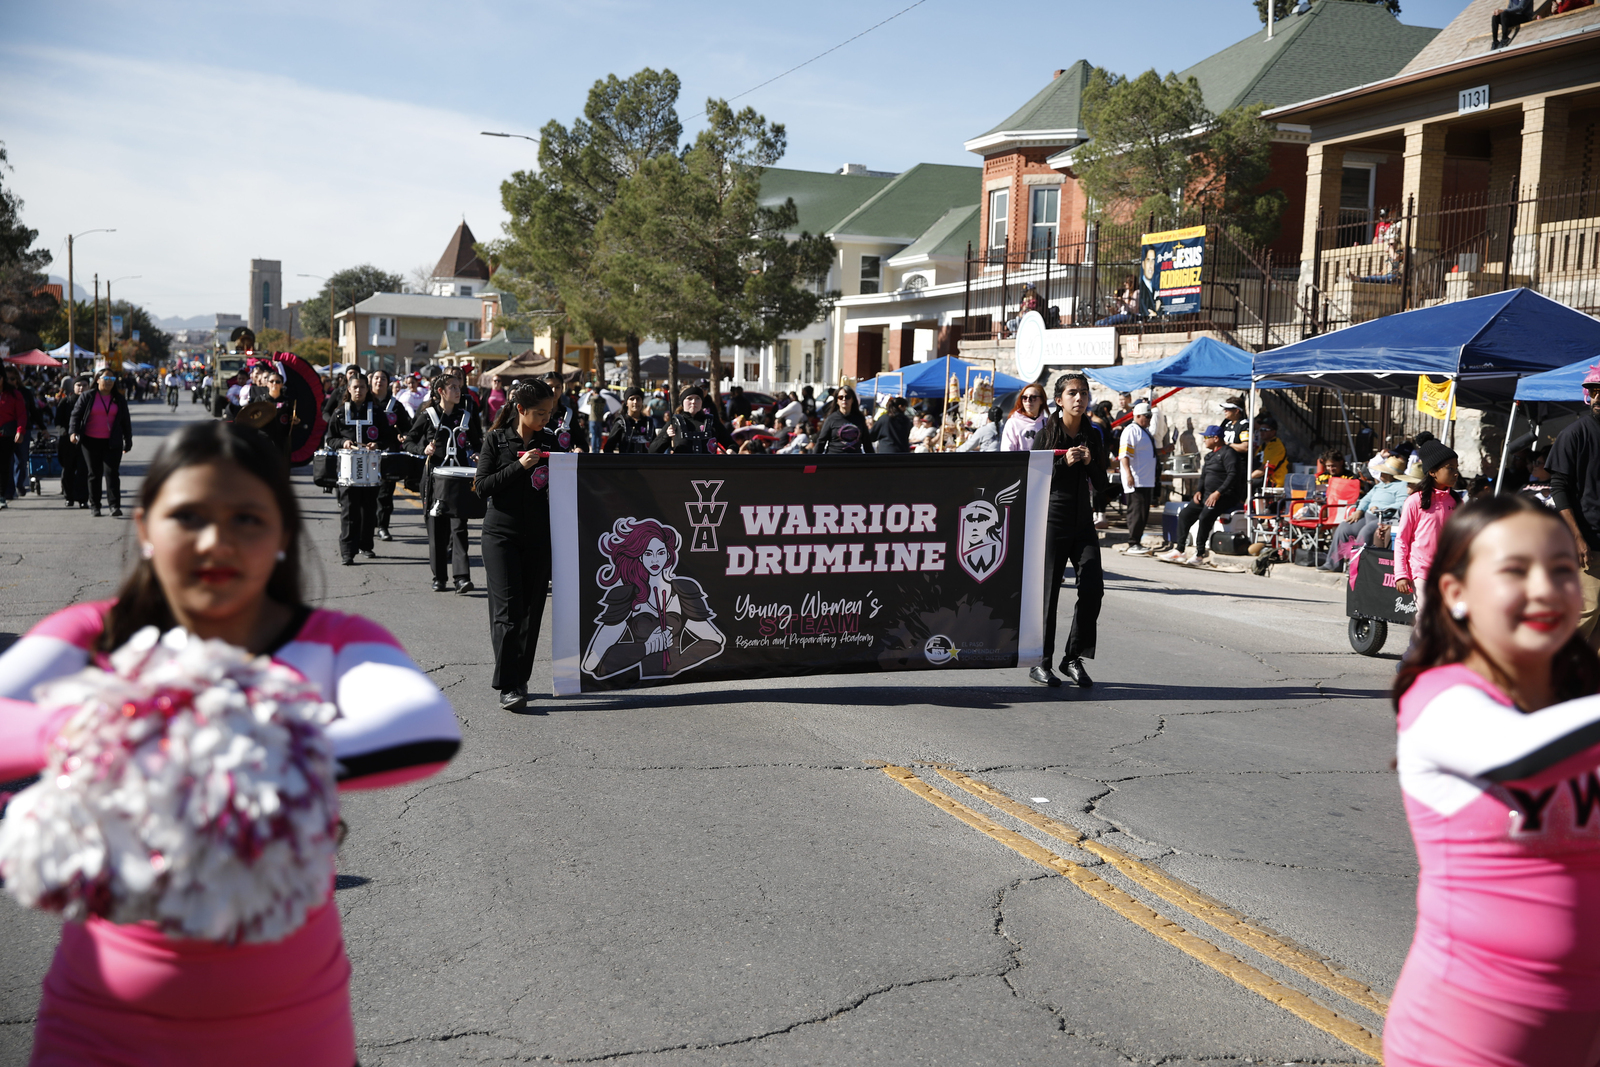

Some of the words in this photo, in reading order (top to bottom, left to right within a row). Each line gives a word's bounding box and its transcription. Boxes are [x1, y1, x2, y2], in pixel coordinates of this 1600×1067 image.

[1462, 89, 1486, 110] 1131
[1173, 246, 1202, 269] JESUS
[1160, 267, 1202, 289] RODRIGUEZ
[1077, 341, 1113, 356] MOORE
[739, 503, 938, 536] WARRIOR
[725, 542, 947, 576] DRUMLINE
[734, 593, 792, 630] Young
[759, 612, 859, 637] STEAM
[735, 635, 770, 649] Research
[772, 635, 789, 649] and
[789, 632, 837, 649] Preparatory
[840, 631, 874, 647] Academy
[1503, 768, 1600, 837] YW
